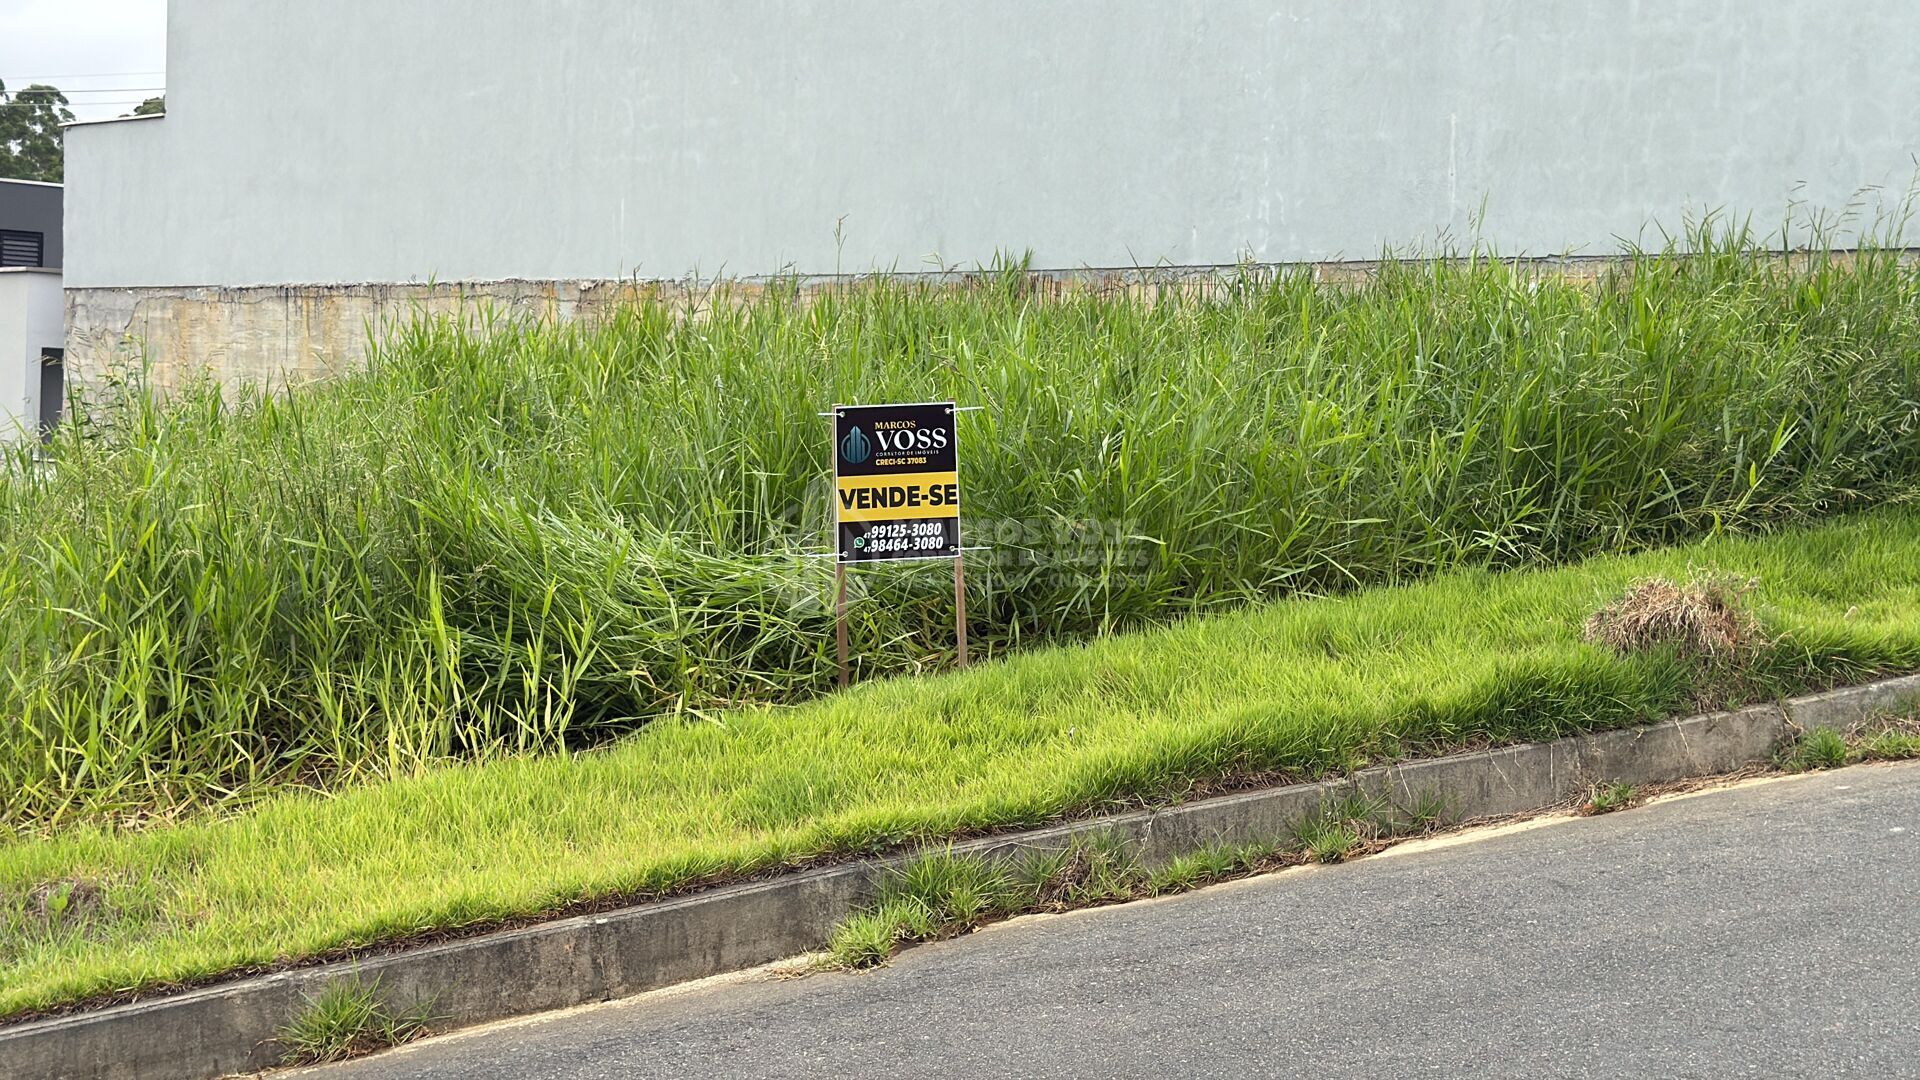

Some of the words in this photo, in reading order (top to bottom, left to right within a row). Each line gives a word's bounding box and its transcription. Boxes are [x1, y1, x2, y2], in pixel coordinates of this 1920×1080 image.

[875, 420, 917, 430] MARCOS
[875, 427, 947, 451] VOSS
[875, 457, 906, 466] CRECI-SC
[907, 456, 927, 465] 37083
[838, 484, 958, 510] VENDE-SE
[871, 522, 942, 539] 99125-3080
[871, 536, 944, 553] 98464-3080
